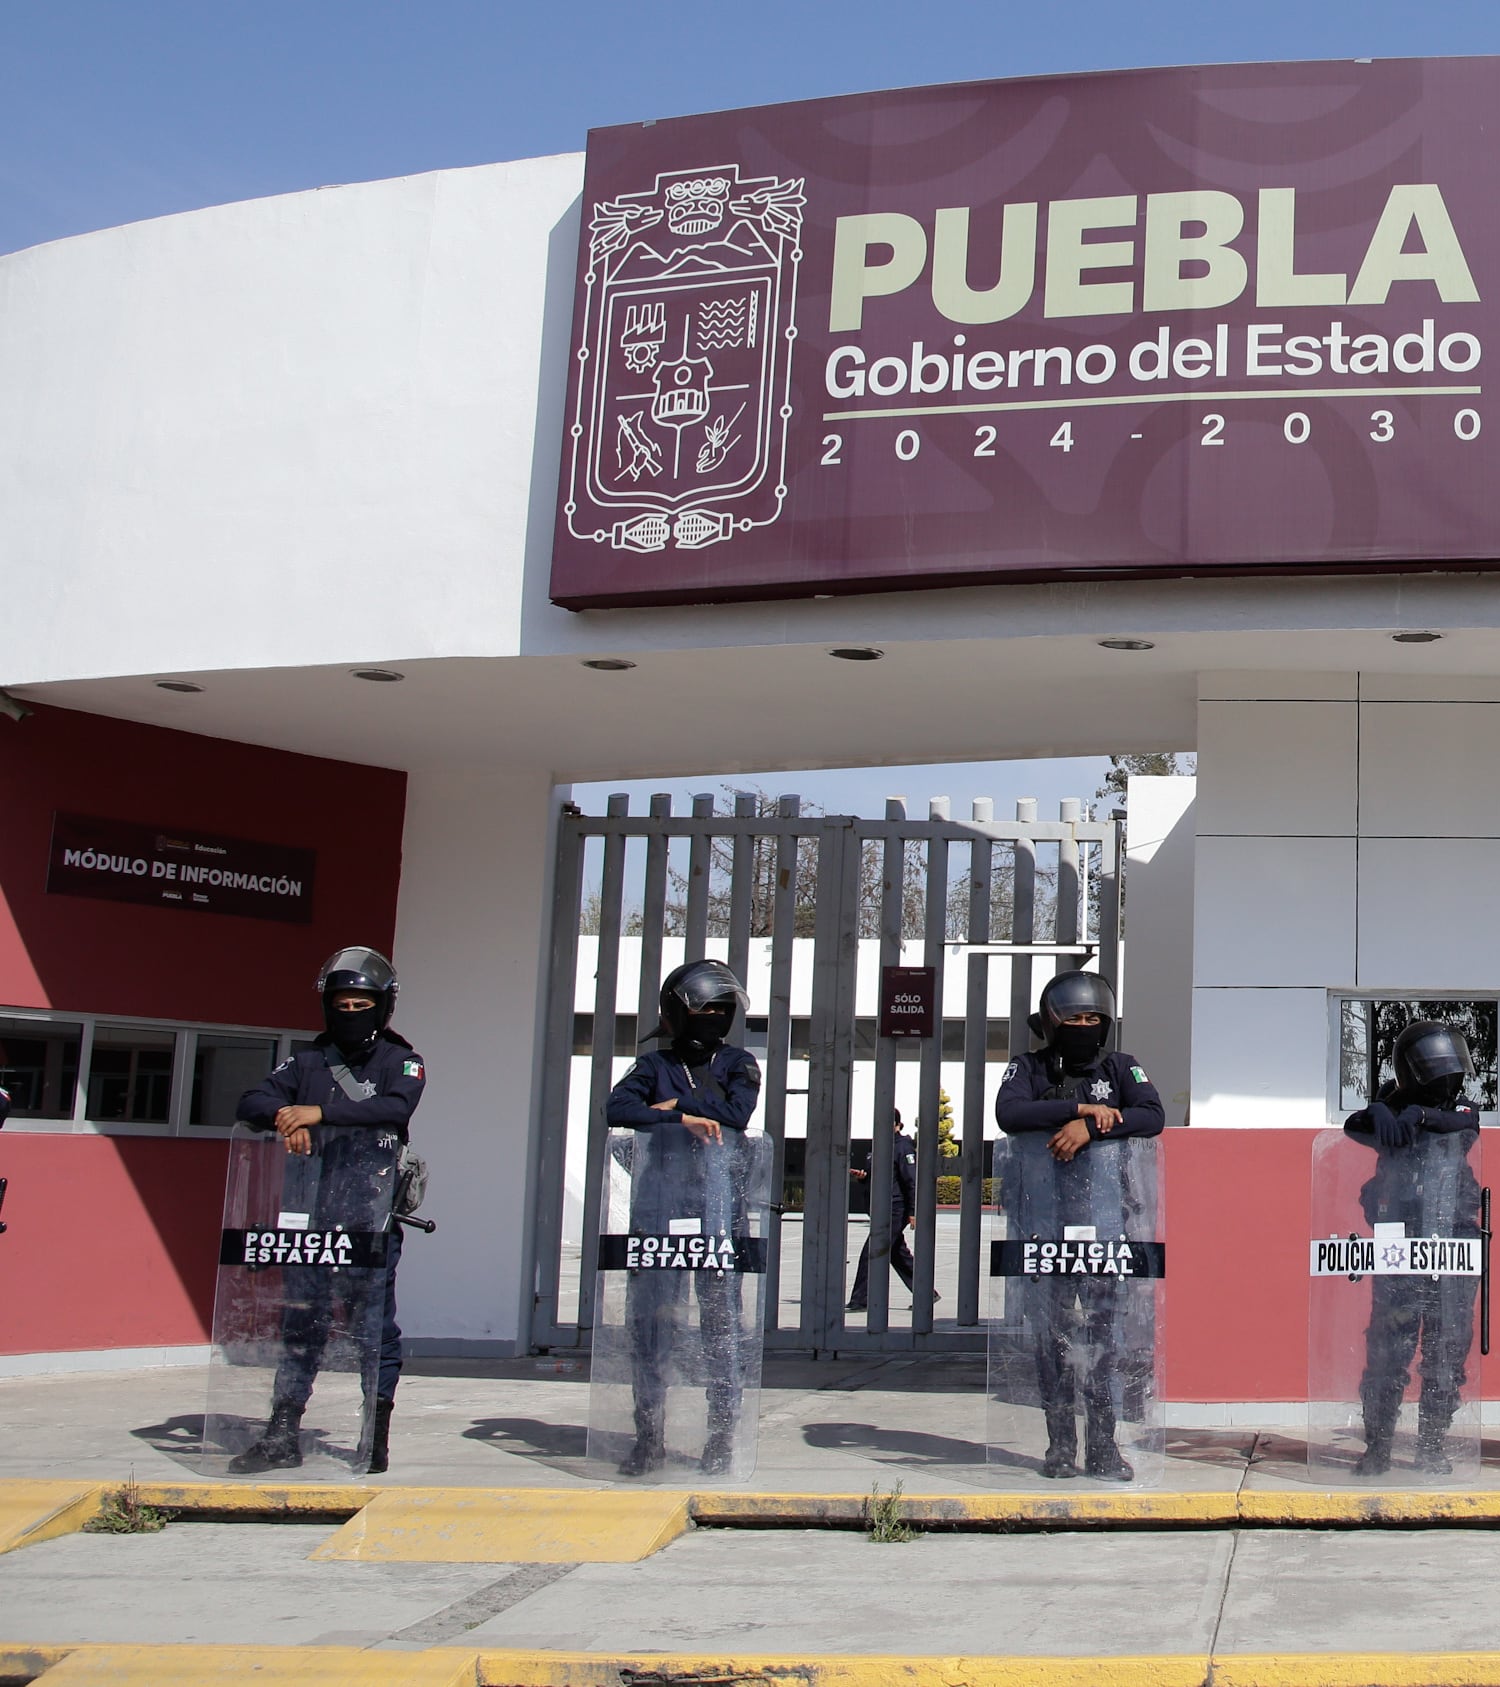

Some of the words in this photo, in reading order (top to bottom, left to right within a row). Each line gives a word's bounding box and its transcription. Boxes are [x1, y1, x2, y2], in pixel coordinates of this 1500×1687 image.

[828, 183, 1482, 333] PUEBLA
[825, 333, 1117, 399] Gobierno
[1128, 323, 1229, 381] del
[1246, 318, 1482, 377] Estado
[63, 847, 148, 877] MÓDULO
[151, 860, 177, 880] DE
[180, 864, 302, 898] INFORMACIÓN
[894, 992, 922, 1004] SÓLO
[890, 1005, 925, 1014] SALIDA
[245, 1232, 353, 1249] POLICÍA
[244, 1248, 352, 1264] ESTATAL
[1023, 1241, 1133, 1258] POLICÍA
[1317, 1242, 1375, 1272] POLICIA
[1409, 1241, 1474, 1271] ESTATAL
[626, 1253, 734, 1269] ESTATAL
[1023, 1258, 1134, 1274] ESTATAL
